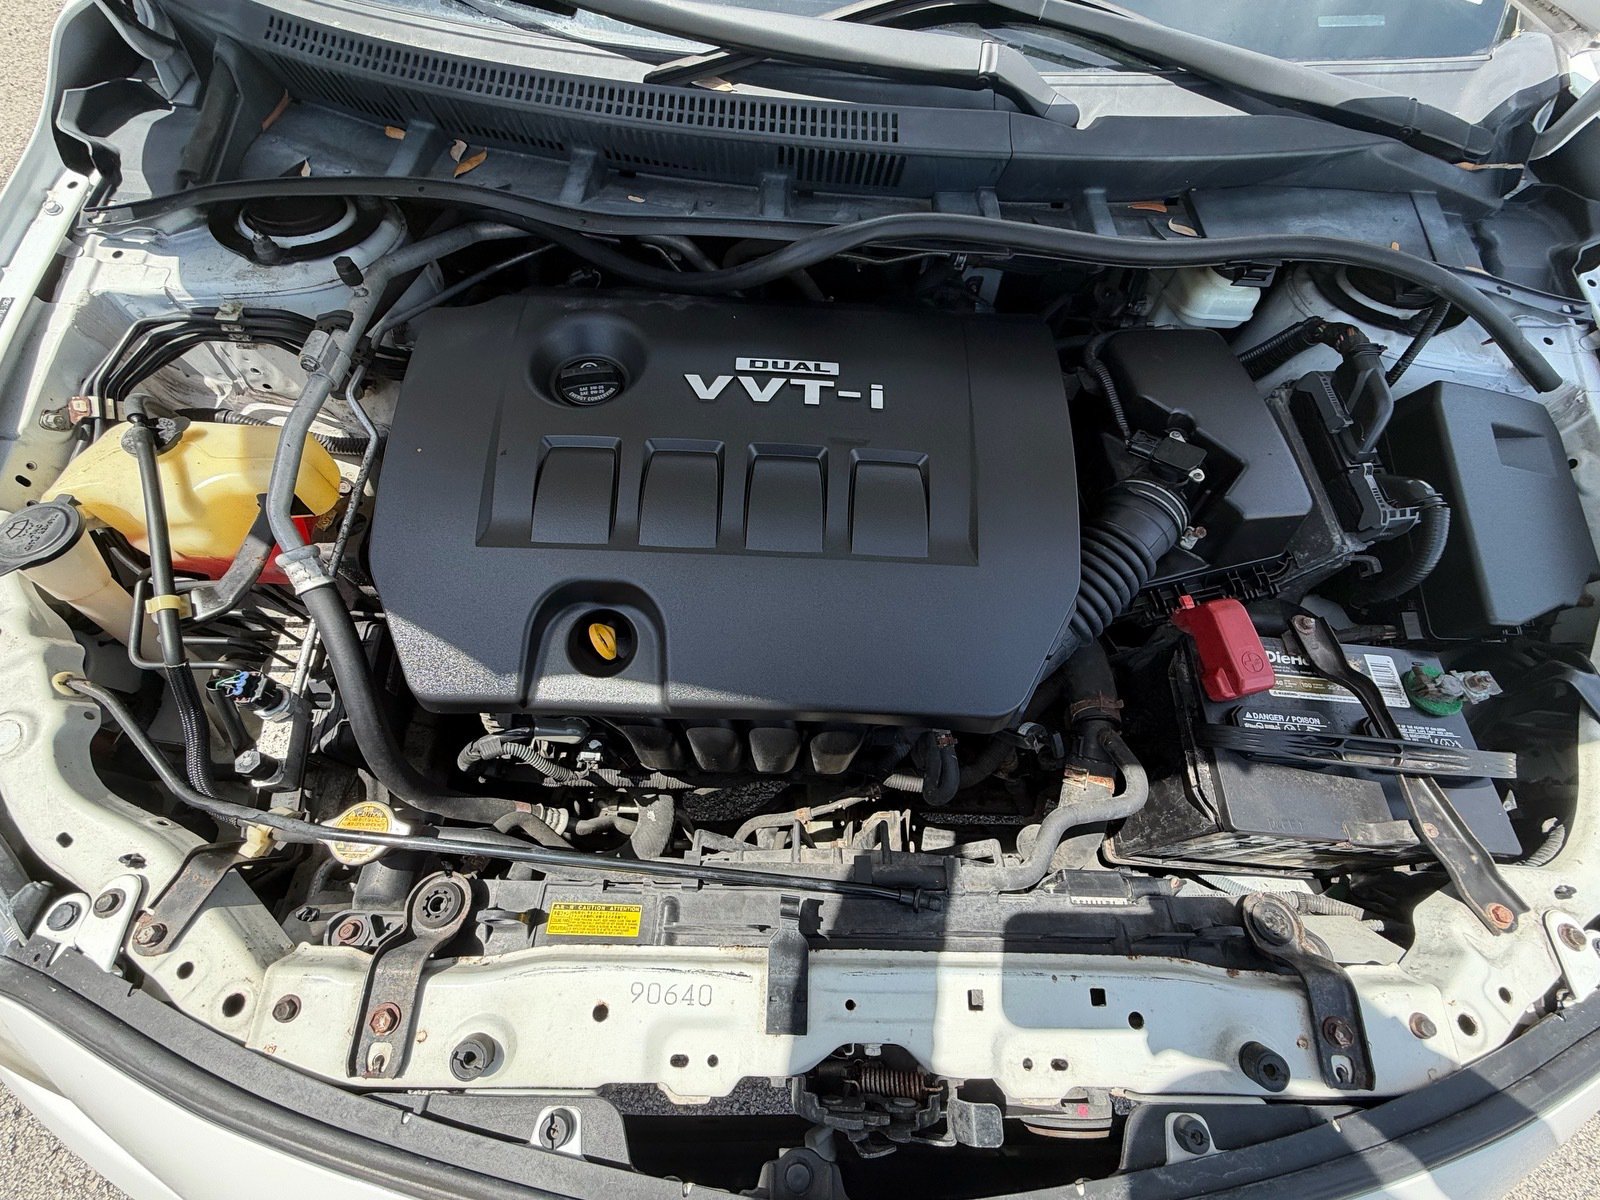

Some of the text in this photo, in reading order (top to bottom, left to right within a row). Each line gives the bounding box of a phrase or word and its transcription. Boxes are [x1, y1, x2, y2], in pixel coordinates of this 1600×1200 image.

[749, 359, 831, 373] DUAL
[569, 387, 616, 401] ENERGY CONSERVING
[684, 373, 884, 410] VVT-i
[1252, 712, 1284, 721] DANGER
[1291, 715, 1321, 725] POISON
[630, 981, 713, 1007] 90640
